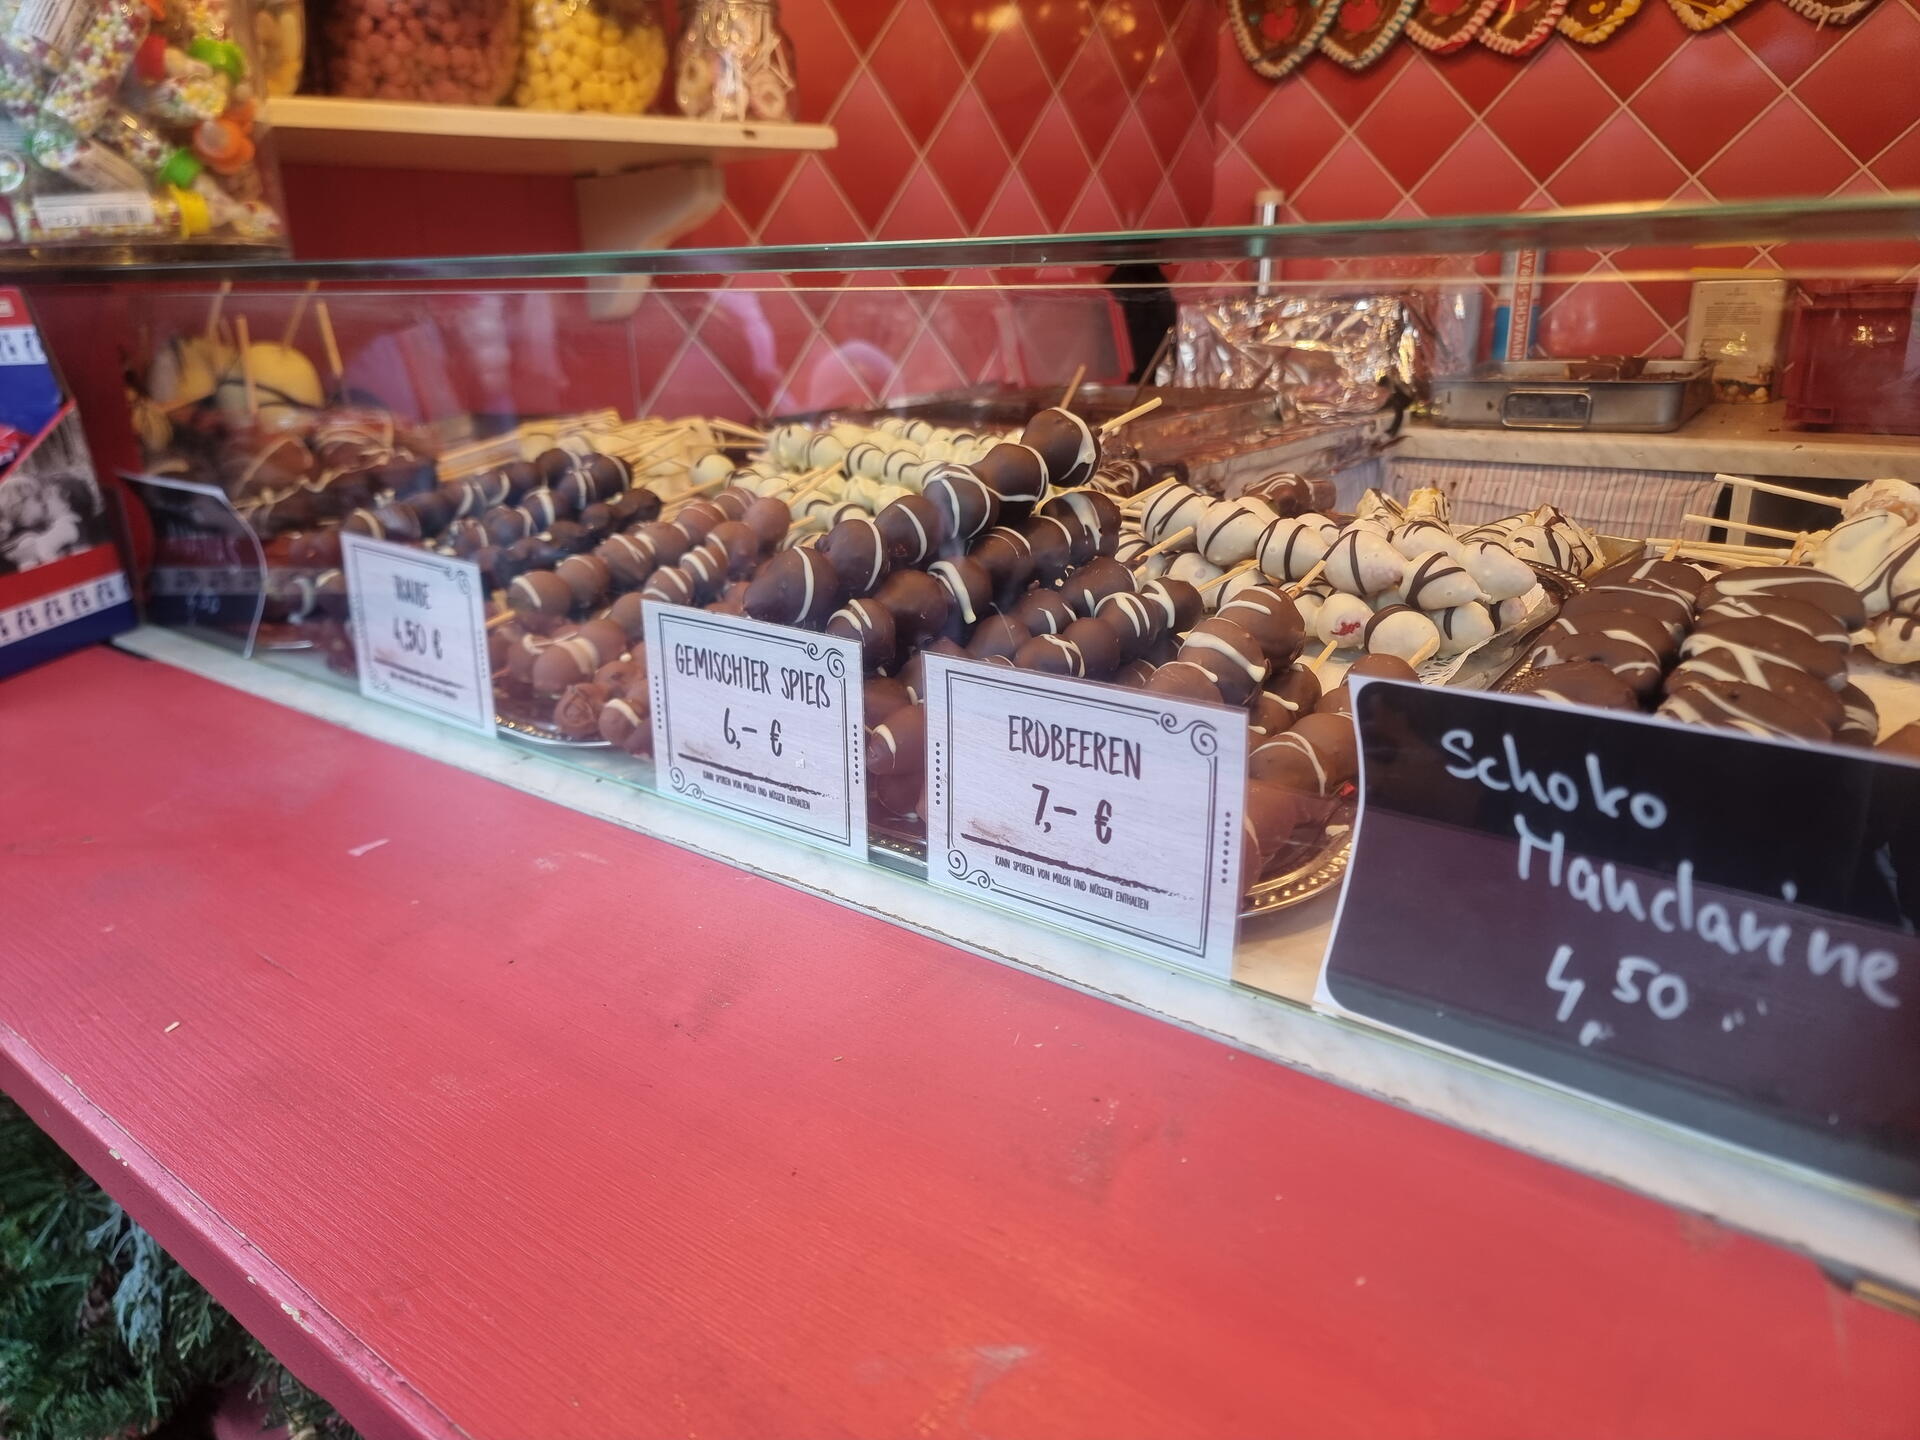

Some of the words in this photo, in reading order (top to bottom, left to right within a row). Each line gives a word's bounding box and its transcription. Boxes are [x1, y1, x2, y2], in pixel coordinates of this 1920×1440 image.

[433, 628, 443, 660] €
[675, 643, 771, 695] GEMISCHTER
[780, 667, 831, 709] SPIEß
[769, 719, 783, 757] €
[1008, 714, 1141, 780] ERDBEEREN
[1440, 728, 1669, 830] Schoko
[1094, 799, 1113, 845] €
[995, 855, 1011, 868] KANN
[1013, 860, 1035, 876] SPUREN
[1037, 867, 1051, 881] VON
[1052, 872, 1071, 887] MILCH
[1073, 878, 1087, 892] UND
[1089, 883, 1113, 899] NÜSSEN
[1115, 891, 1149, 911] ENTHALTEN
[1513, 812, 1900, 1009] Mandarine
